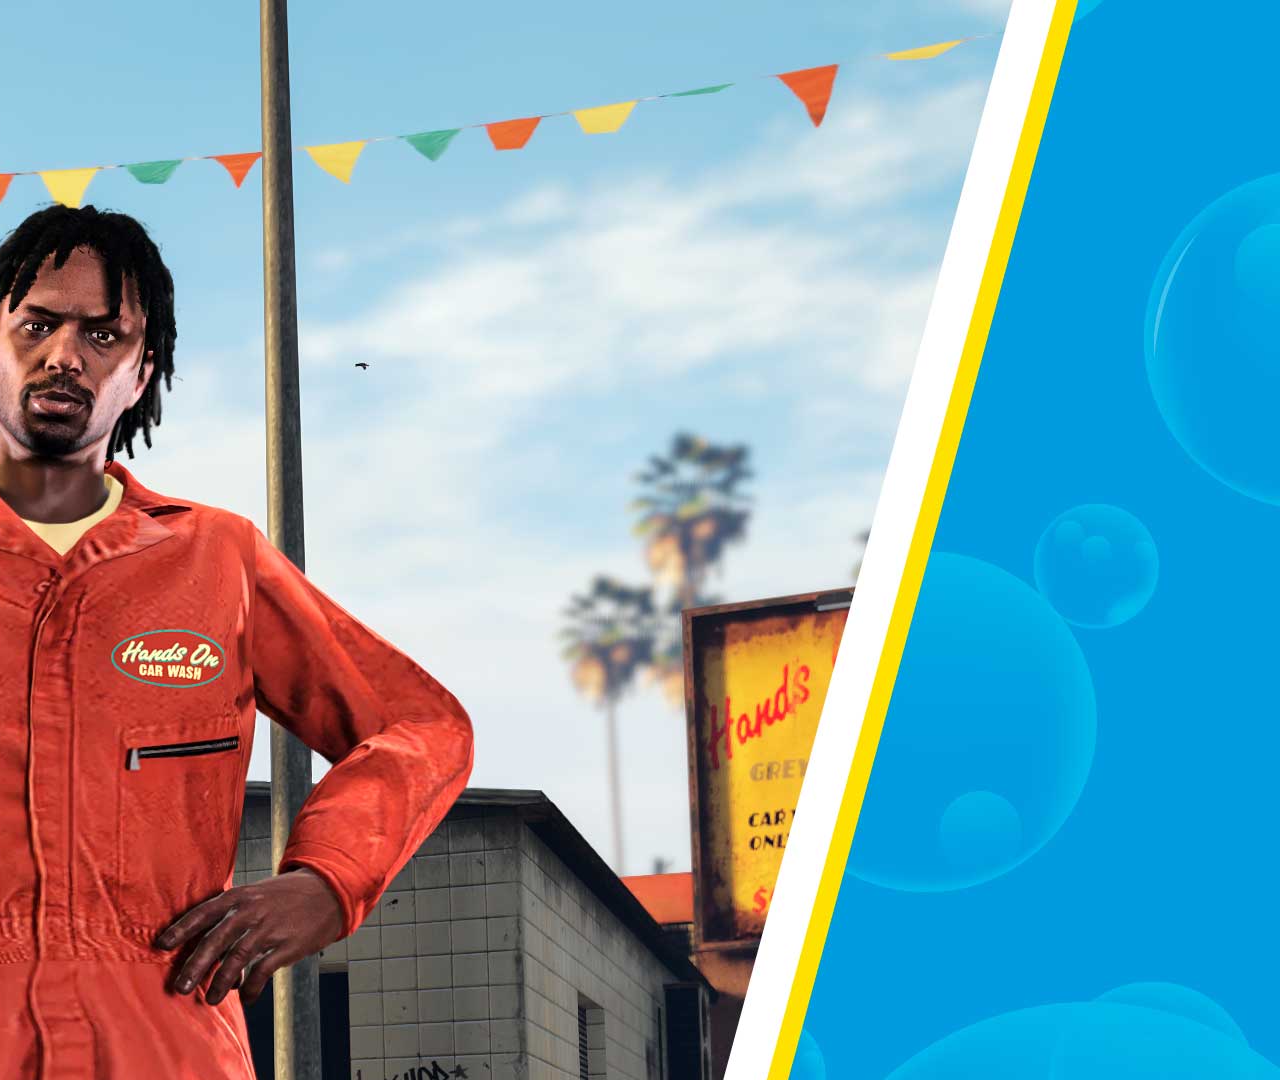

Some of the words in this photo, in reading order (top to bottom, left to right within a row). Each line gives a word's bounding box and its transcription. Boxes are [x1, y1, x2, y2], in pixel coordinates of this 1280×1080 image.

[121, 641, 188, 664] Hands
[190, 643, 220, 667] On
[139, 664, 163, 677] CAR
[167, 665, 202, 680] WASH
[707, 663, 811, 770] Hands
[748, 809, 786, 828] CAR
[749, 833, 790, 851] ONL
